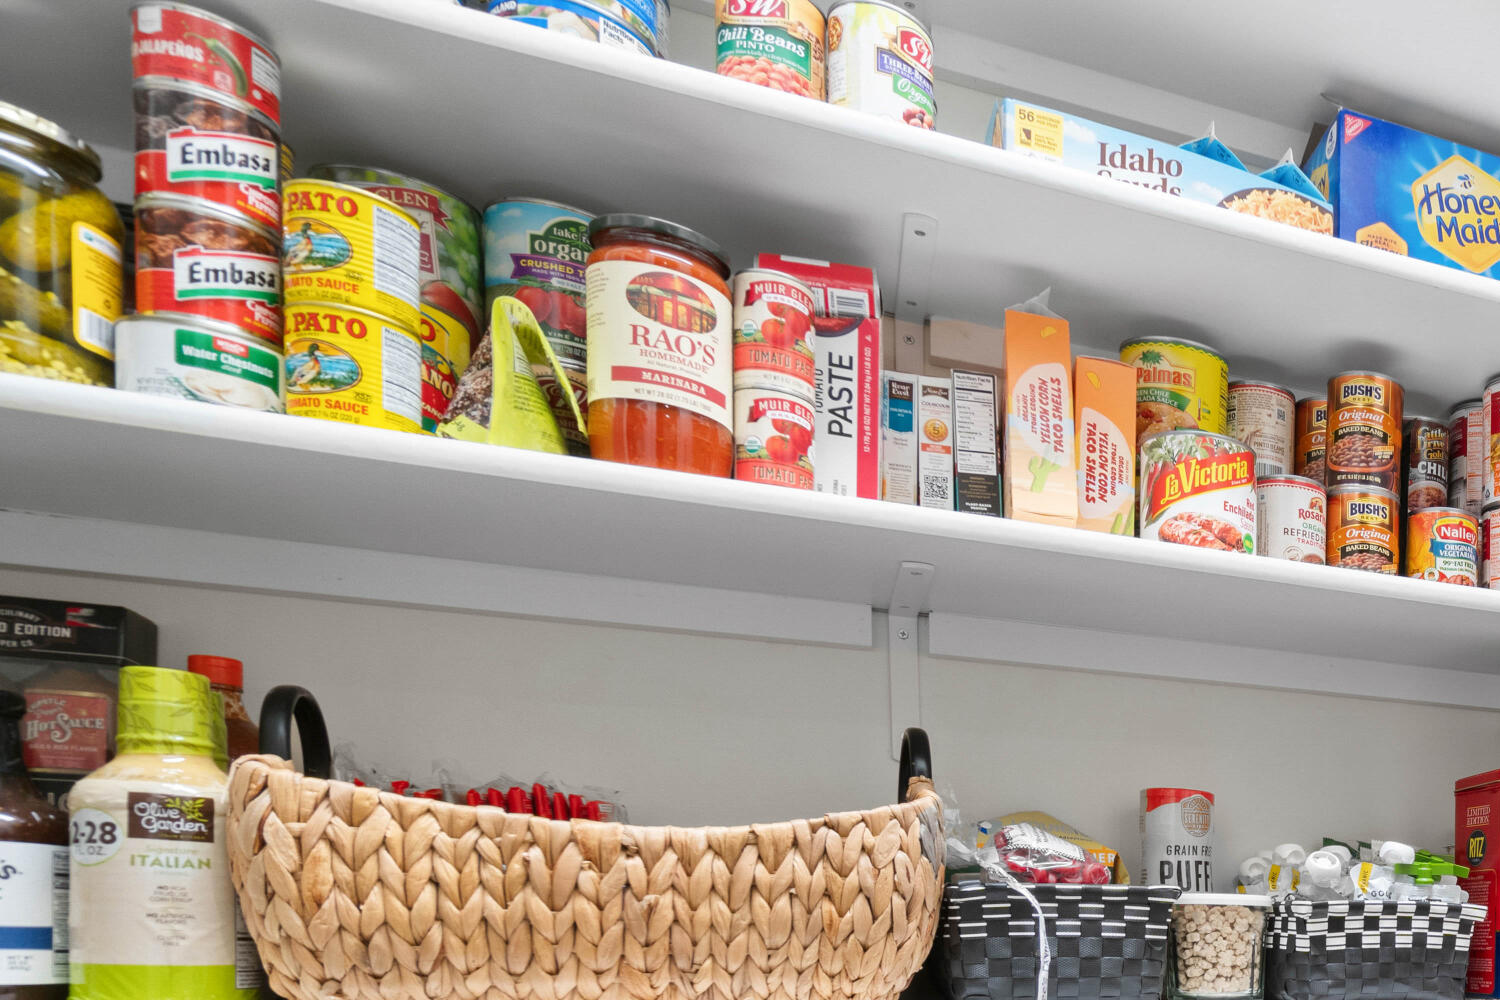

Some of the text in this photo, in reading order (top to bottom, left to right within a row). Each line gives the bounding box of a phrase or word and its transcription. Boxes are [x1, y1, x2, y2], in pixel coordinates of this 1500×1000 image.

[603, 19, 635, 45] Nutrition
[603, 28, 625, 45] Facts
[138, 39, 204, 63] JALAPEÑOS
[718, 27, 806, 58] Chili Beans
[736, 40, 775, 53] PINTO
[1019, 108, 1035, 122] 56
[181, 142, 271, 173] Embasa
[1097, 141, 1184, 178] Idaho
[287, 191, 358, 218] PATO
[377, 188, 429, 209] GLEN
[553, 227, 578, 240] take
[188, 261, 276, 289] Embasa
[520, 259, 574, 275] CRUSHED
[316, 279, 360, 295] SAUCE
[754, 283, 786, 296] MUIR
[293, 312, 367, 340] PATO
[629, 324, 715, 367] RAO'S
[182, 344, 274, 379] Water Chestnuts
[640, 348, 709, 374] HOMEMADE
[749, 350, 791, 368] TOMATO
[641, 371, 706, 396] MARINARA
[1136, 366, 1193, 386] Palmas
[815, 367, 824, 414] TOMATO
[827, 351, 854, 439] PASTE
[1149, 388, 1171, 398] CHILE
[1343, 385, 1382, 400] BUSH'S
[324, 400, 369, 416] SAUCE
[758, 400, 791, 412] MUIR
[1029, 383, 1038, 435] STONE GROUND
[1038, 377, 1052, 445] YELLOW CORN
[1156, 396, 1178, 408] SAUCE
[1050, 377, 1065, 454] TACO SHELLS
[1338, 409, 1385, 424] Original
[1338, 426, 1384, 438] BAKED BEANS
[1417, 426, 1446, 439] Cattle
[1085, 422, 1097, 504] TACO SHELLS
[1424, 448, 1444, 460] Gold
[753, 465, 796, 485] TOMATO
[1098, 431, 1109, 503] YELLOW CORN
[1161, 457, 1249, 505] La Victoria
[1223, 501, 1255, 523] Enchilada
[1246, 498, 1255, 511] Red
[1349, 502, 1388, 520] BUSH'S
[1283, 527, 1321, 543] REFRIED
[1345, 528, 1391, 543] Original
[1440, 525, 1476, 544] Nalley
[1345, 543, 1391, 557] BAKED BEANS
[1439, 549, 1476, 562] VEGETARIAN
[1444, 543, 1473, 551] ORIGINAL
[14, 623, 72, 638] EDITION
[133, 802, 181, 819] Olive
[1466, 806, 1491, 817] LIMITED
[141, 816, 208, 834] Garden
[1466, 816, 1490, 826] EDITION
[1166, 845, 1197, 857] GRAIN
[1469, 835, 1485, 859] RITZ
[130, 855, 212, 869] ITALIAN
